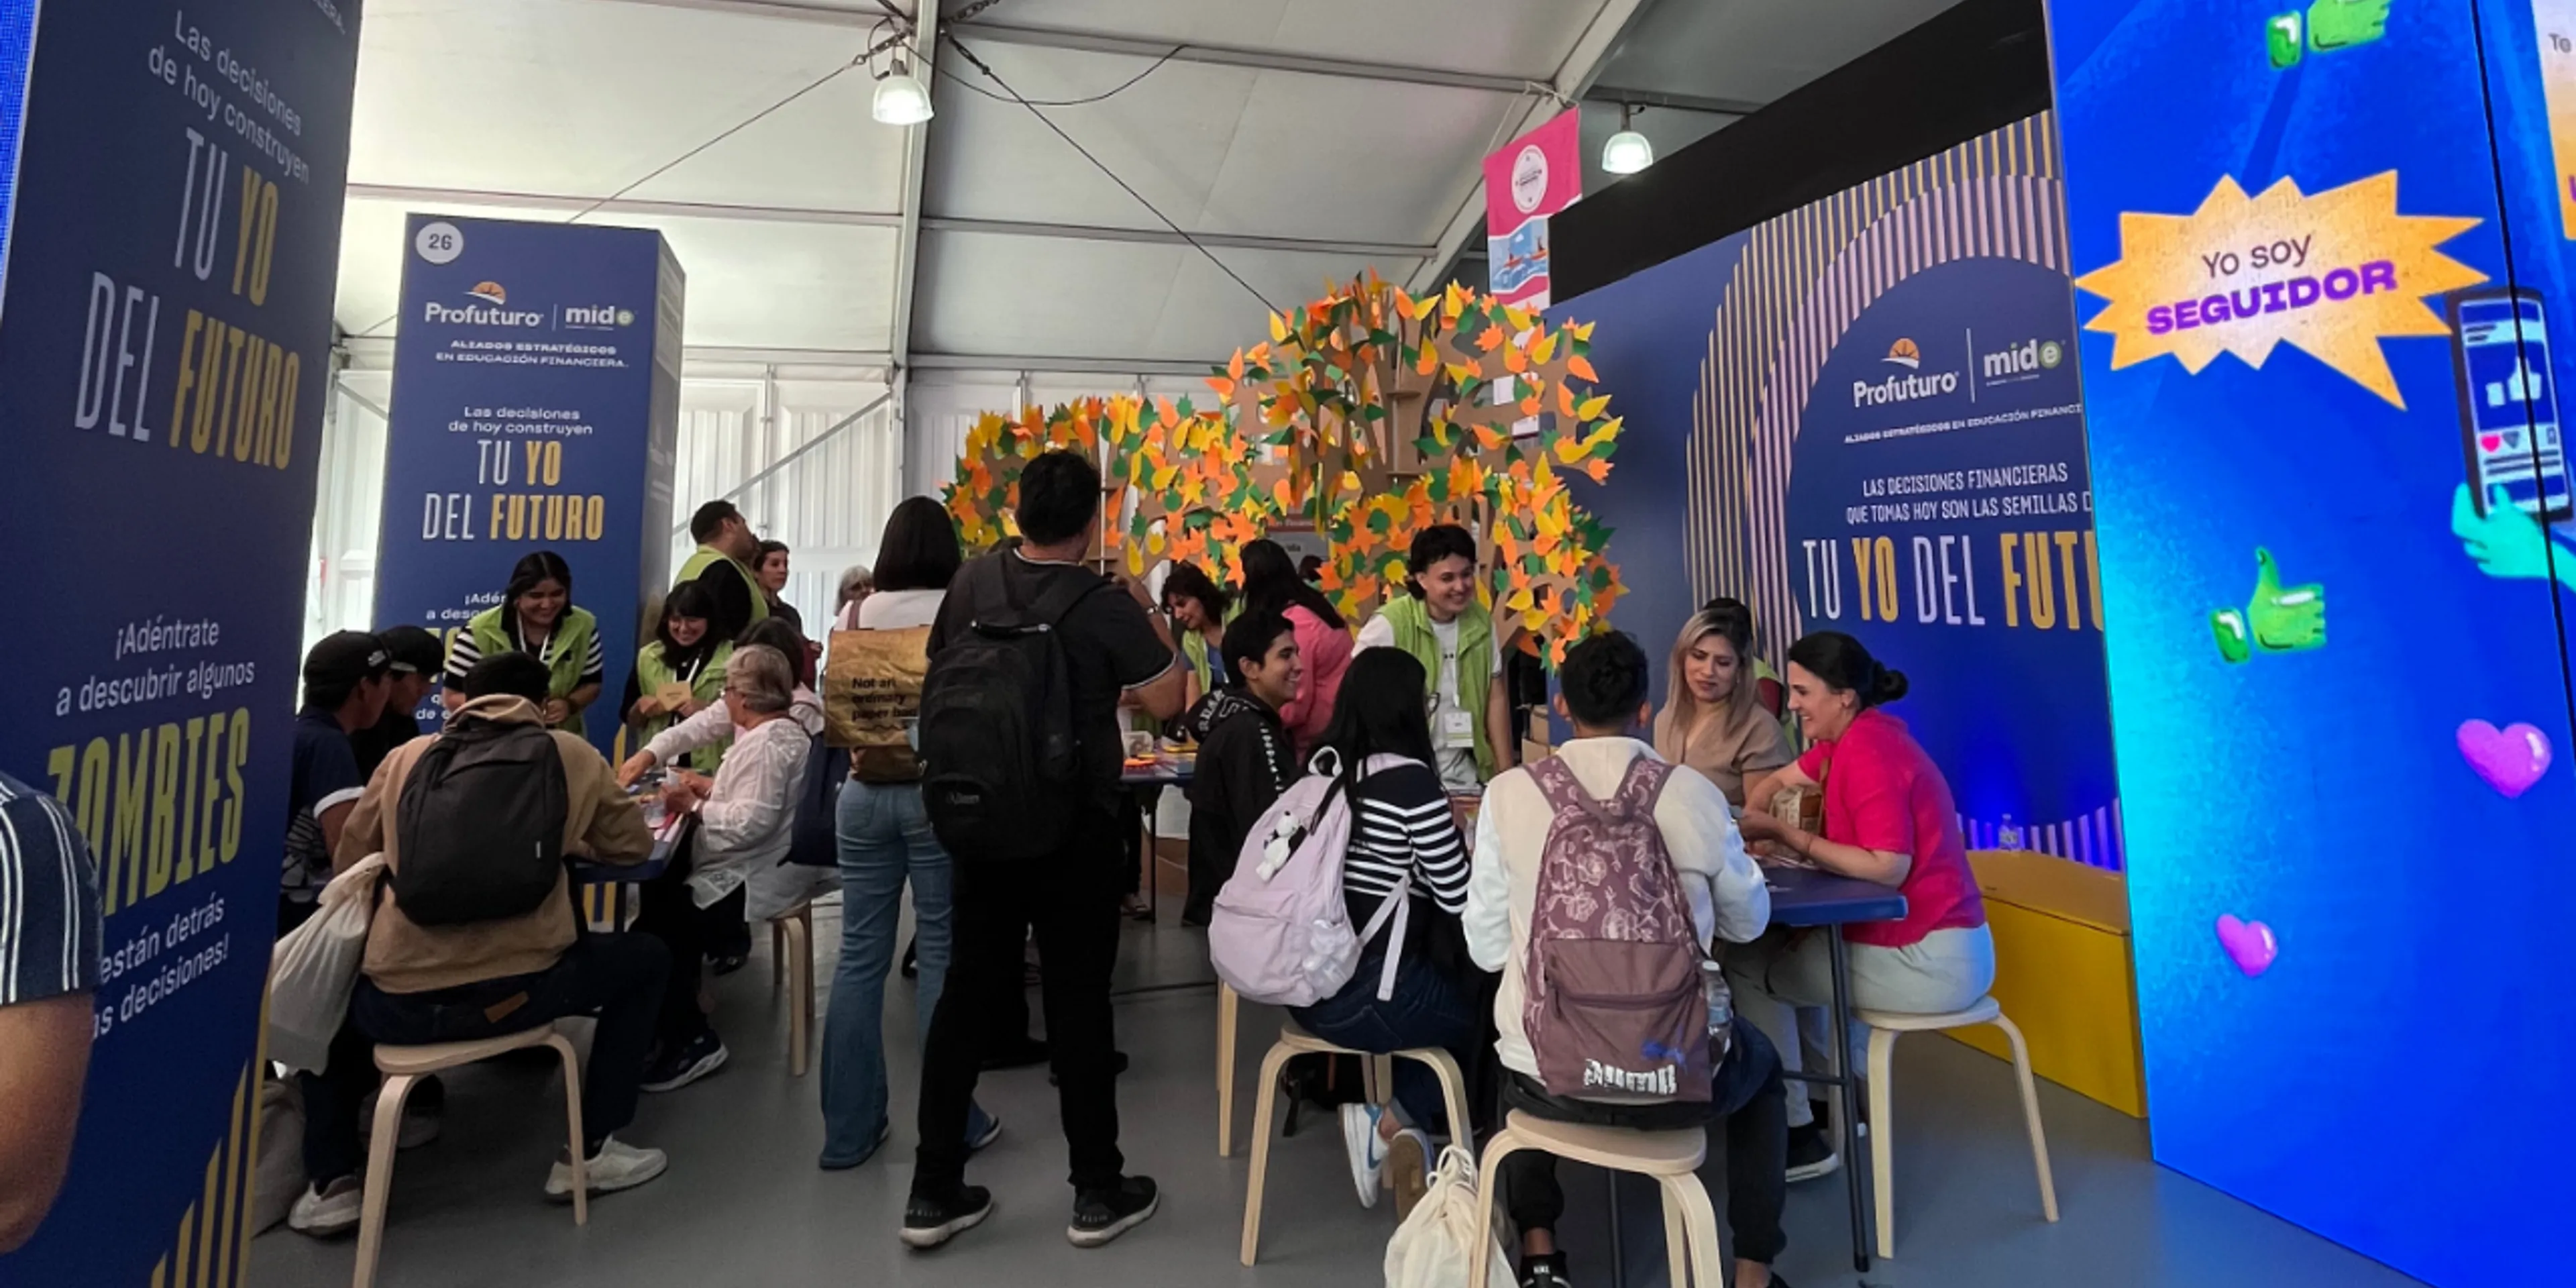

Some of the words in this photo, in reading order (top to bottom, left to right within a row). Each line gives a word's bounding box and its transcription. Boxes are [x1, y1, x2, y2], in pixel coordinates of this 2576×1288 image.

[174, 9, 212, 62] Las
[216, 48, 302, 137] decisiones
[148, 45, 177, 86] de
[184, 64, 221, 121] hoy
[224, 103, 310, 185] construyen
[174, 127, 228, 281] TU
[231, 165, 279, 307] YO
[428, 233, 453, 251] 26
[2202, 251, 2240, 278] Yo
[2250, 233, 2312, 269] soy
[425, 302, 541, 327] Profuturo
[2145, 260, 2398, 335] SEGUIDOR
[74, 271, 160, 442] DEL
[169, 309, 300, 470] FUTURO
[435, 353, 454, 361] EN
[457, 353, 537, 364] EDUCACIÓN
[540, 356, 629, 368] FINANCIERA.
[451, 339, 513, 351] ALIADOS
[516, 341, 616, 356] ESTRATÉGICOS
[1854, 371, 1957, 408] Profuturo
[1984, 339, 2061, 377] mide
[448, 420, 468, 432] de
[472, 421, 501, 435] hoy
[505, 421, 593, 437] construyen
[464, 407, 492, 418] Las
[496, 407, 580, 421] decisiones
[1844, 427, 1880, 444] ALIADOS
[1951, 420, 1966, 430] EN
[1968, 410, 2029, 428] EDUCACIÓN
[477, 439, 512, 486] TU
[525, 439, 562, 486] YO
[1863, 479, 1885, 498] LAS
[1887, 471, 1964, 496] DECISIONES
[1968, 462, 2068, 490] FINANCIERAS
[422, 493, 475, 541] DEL
[490, 494, 604, 541] FUTURO
[1846, 506, 1868, 525] QUE
[1871, 503, 1911, 523] TOMAS
[1913, 501, 1938, 521] HOY
[1941, 500, 1970, 519] SON
[1972, 498, 2000, 518] LAS
[2002, 492, 2078, 516] SEMILLAS
[1803, 539, 1841, 620] TU
[1851, 535, 1900, 623] YO
[1913, 535, 1986, 626] DEL
[115, 614, 220, 661] ¡Adéntrate
[426, 610, 436, 620] a
[56, 686, 71, 716] a
[78, 668, 182, 712] descubrir
[186, 660, 256, 700] algunos
[851, 677, 875, 689] Not
[415, 708, 436, 720] de
[101, 924, 160, 984] están
[165, 891, 224, 949] detrás
[120, 932, 229, 1022] decisiones!
